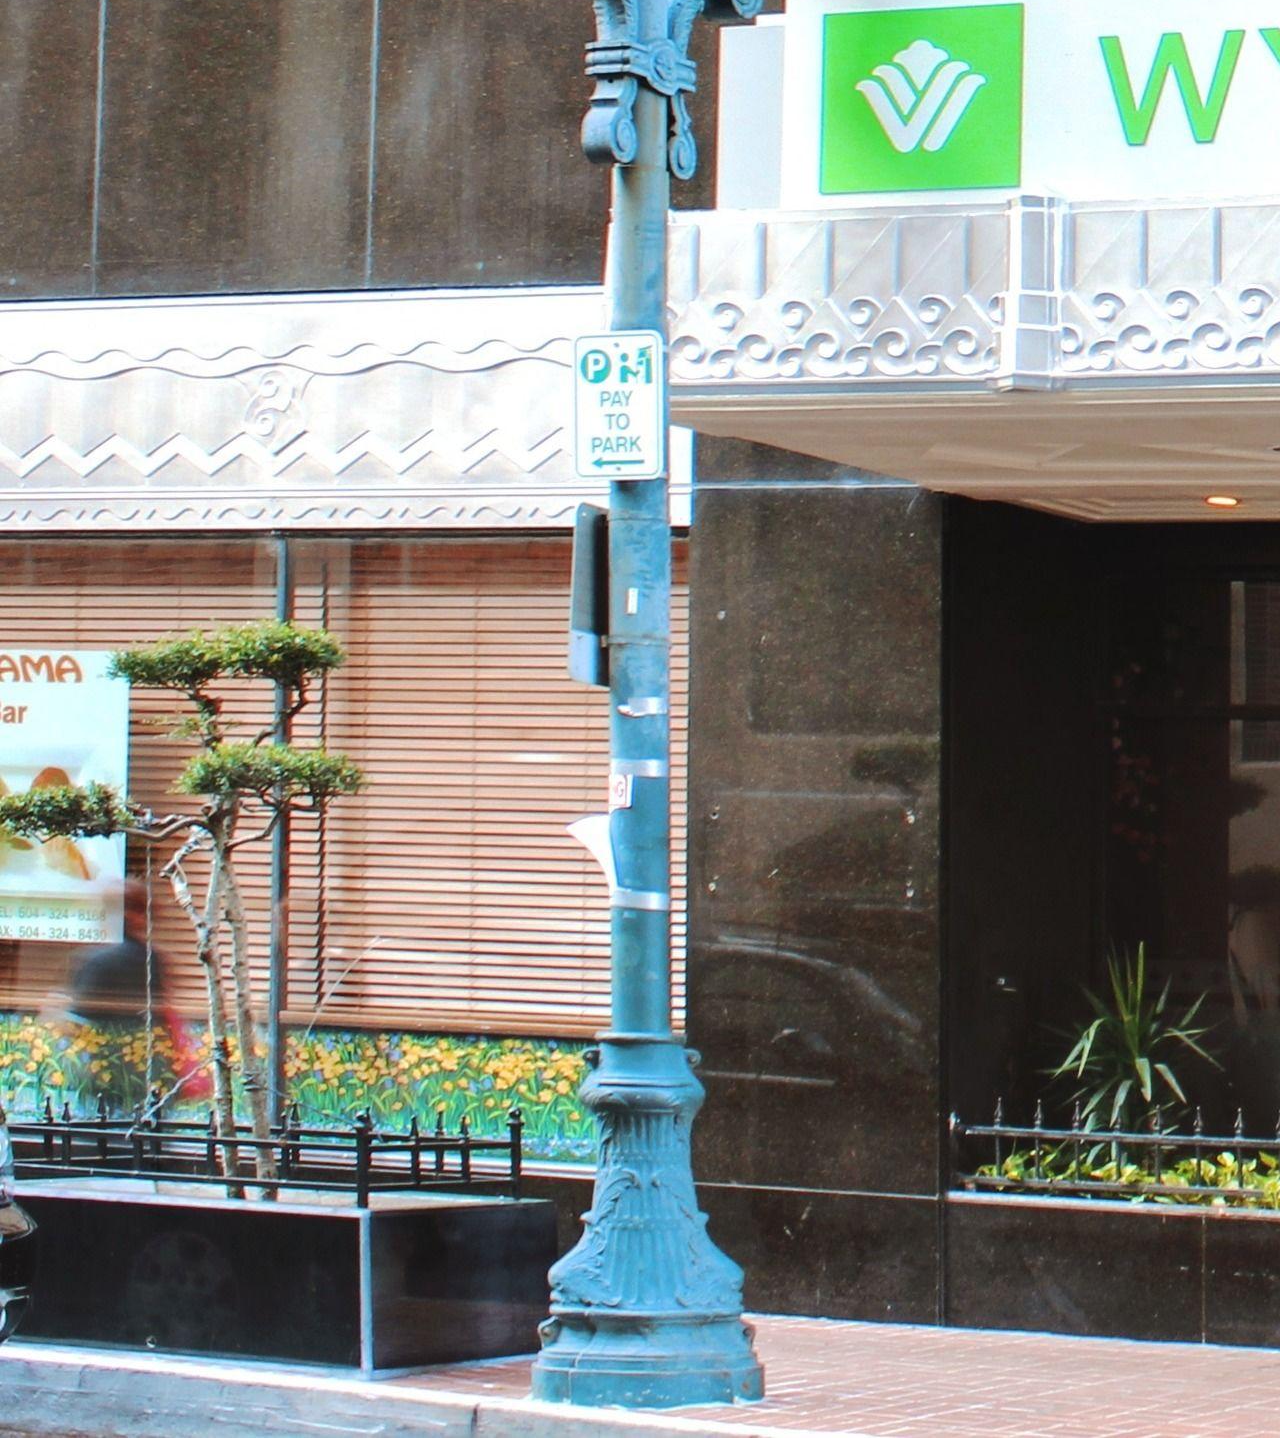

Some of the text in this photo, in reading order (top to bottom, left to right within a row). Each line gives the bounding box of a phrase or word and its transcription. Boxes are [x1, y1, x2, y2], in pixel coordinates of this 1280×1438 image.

[600, 391, 633, 407] PAY
[605, 413, 630, 430] TO
[591, 436, 642, 453] PARK
[0, 703, 27, 724] ar
